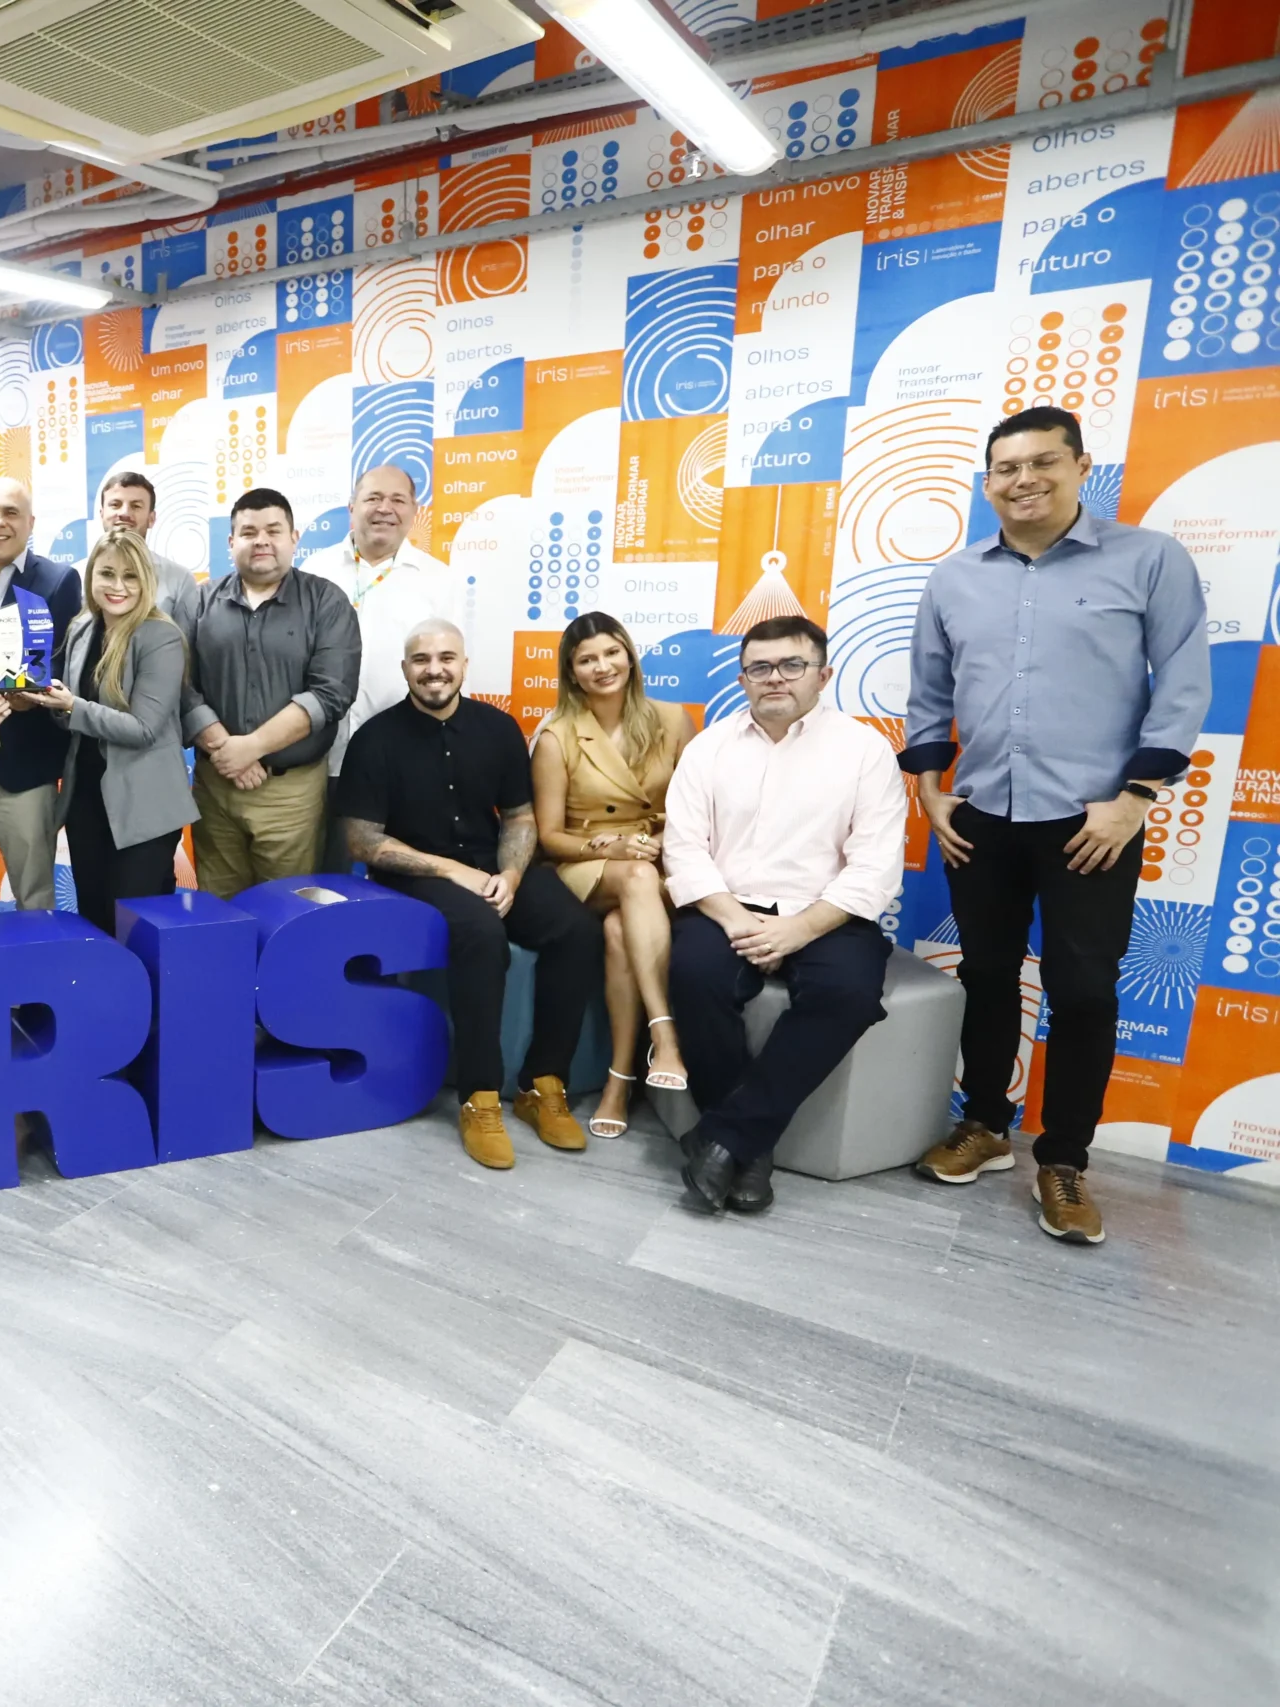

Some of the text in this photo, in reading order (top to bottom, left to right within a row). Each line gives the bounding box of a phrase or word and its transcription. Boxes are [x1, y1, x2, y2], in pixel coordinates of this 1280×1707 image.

[1032, 122, 1116, 153] Olhos
[1027, 159, 1146, 195] abertos
[758, 175, 860, 207] Um novo
[892, 209, 905, 219] &
[1022, 207, 1116, 238] para o
[755, 219, 816, 243] olhar
[753, 256, 826, 282] para o
[1018, 249, 1112, 276] futuro
[214, 290, 251, 308] Olhos
[751, 290, 830, 314] mundo
[215, 315, 267, 335] abertos
[446, 315, 494, 332] Olhos
[215, 345, 257, 363] para o
[445, 343, 513, 363] abertos
[746, 347, 810, 365] Olhos
[151, 359, 204, 377] Um novo
[897, 364, 942, 376] Inovar
[445, 375, 499, 394] para o
[897, 371, 983, 389] Transformar
[151, 386, 183, 402] olhar
[745, 379, 833, 400] abertos
[896, 386, 948, 400] Inspirar
[445, 405, 499, 422] futuro
[743, 416, 813, 436] para o
[444, 449, 518, 466] Um novo
[741, 451, 811, 469] futuro
[443, 479, 487, 494] olhar
[623, 455, 640, 548] TRANSFORMAR
[634, 479, 649, 537] INSPIRAR
[320, 519, 330, 531] o
[442, 510, 495, 526] para o
[1173, 518, 1227, 528] Inovar
[441, 538, 498, 552] mundo
[624, 579, 679, 593] Olhos
[622, 611, 699, 624] abertos
[526, 646, 553, 659] Um
[669, 644, 681, 656] o
[523, 675, 559, 689] olha
[1233, 791, 1247, 802] &
